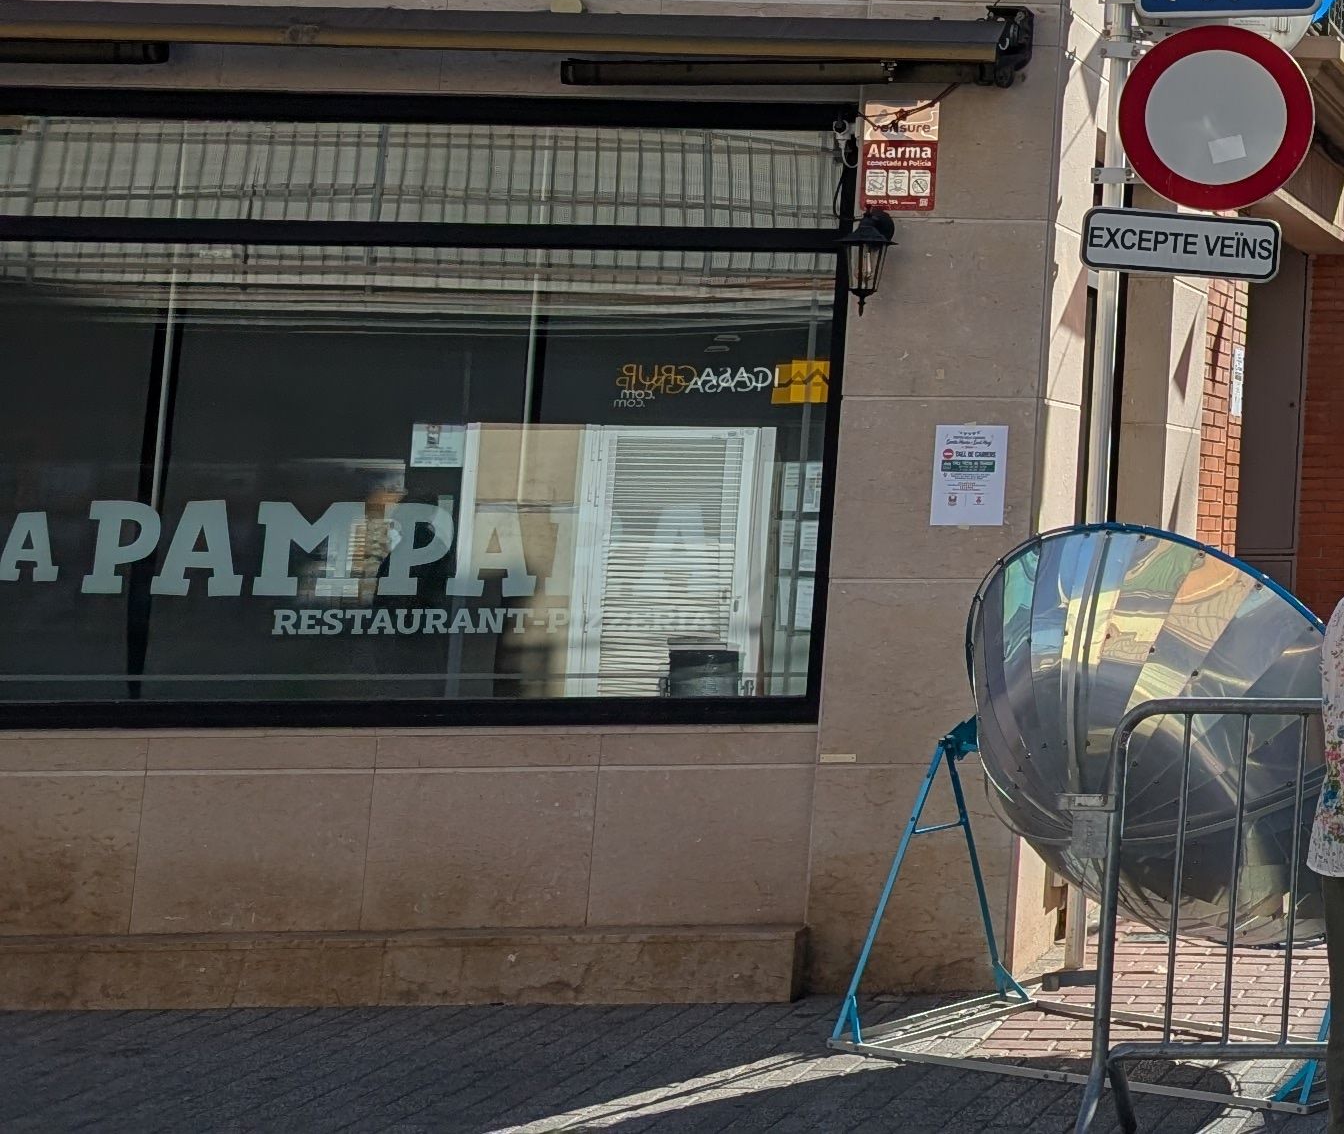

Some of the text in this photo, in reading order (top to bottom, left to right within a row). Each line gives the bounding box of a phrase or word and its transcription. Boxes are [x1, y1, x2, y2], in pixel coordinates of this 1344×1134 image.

[867, 142, 932, 159] Alarma
[1088, 226, 1273, 260] EXCEPTE VEÏNS
